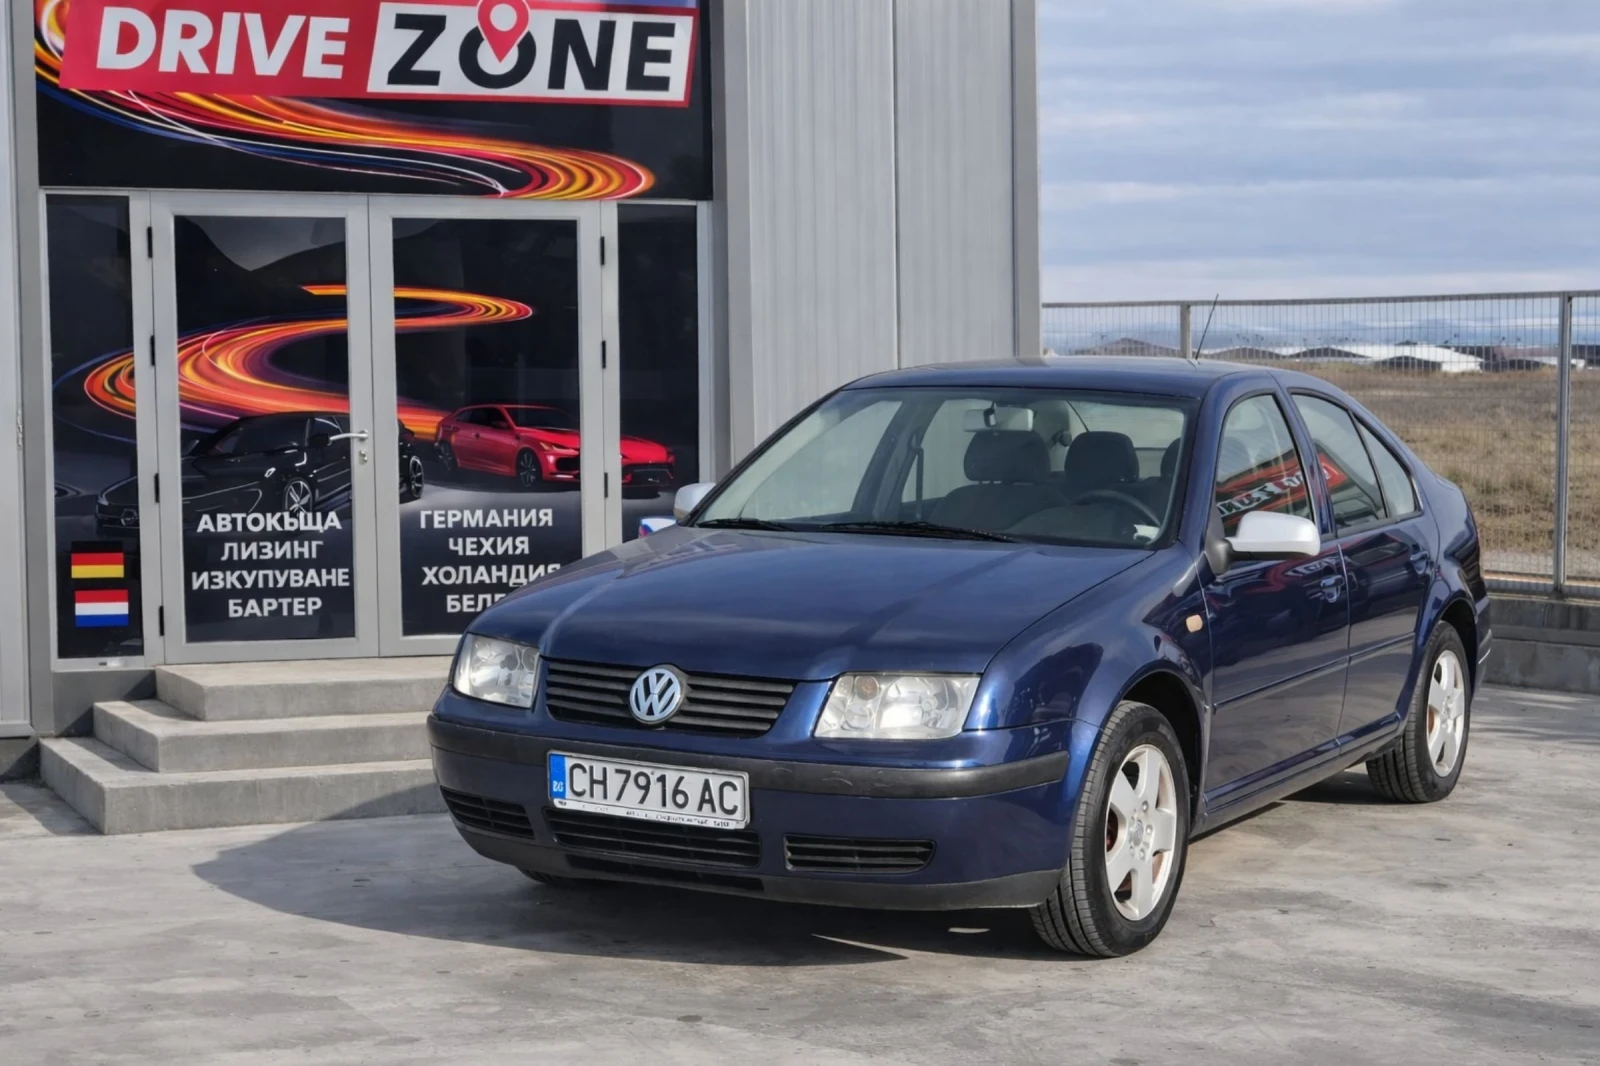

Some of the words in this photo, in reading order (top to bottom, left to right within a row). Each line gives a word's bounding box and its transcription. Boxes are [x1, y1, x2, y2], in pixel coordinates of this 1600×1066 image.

[96, 6, 350, 80] DRIVE
[386, 11, 676, 92] ZONE
[196, 511, 342, 533] АВТОКЪЩА
[420, 508, 553, 529] ГЕРМАНИЯ
[220, 540, 324, 561] ЛИЗИНГ
[448, 536, 530, 556] ЧЕХИЯ
[191, 568, 350, 590] ИЗКУПУВАНЕ
[228, 597, 322, 618] БАРТЕР
